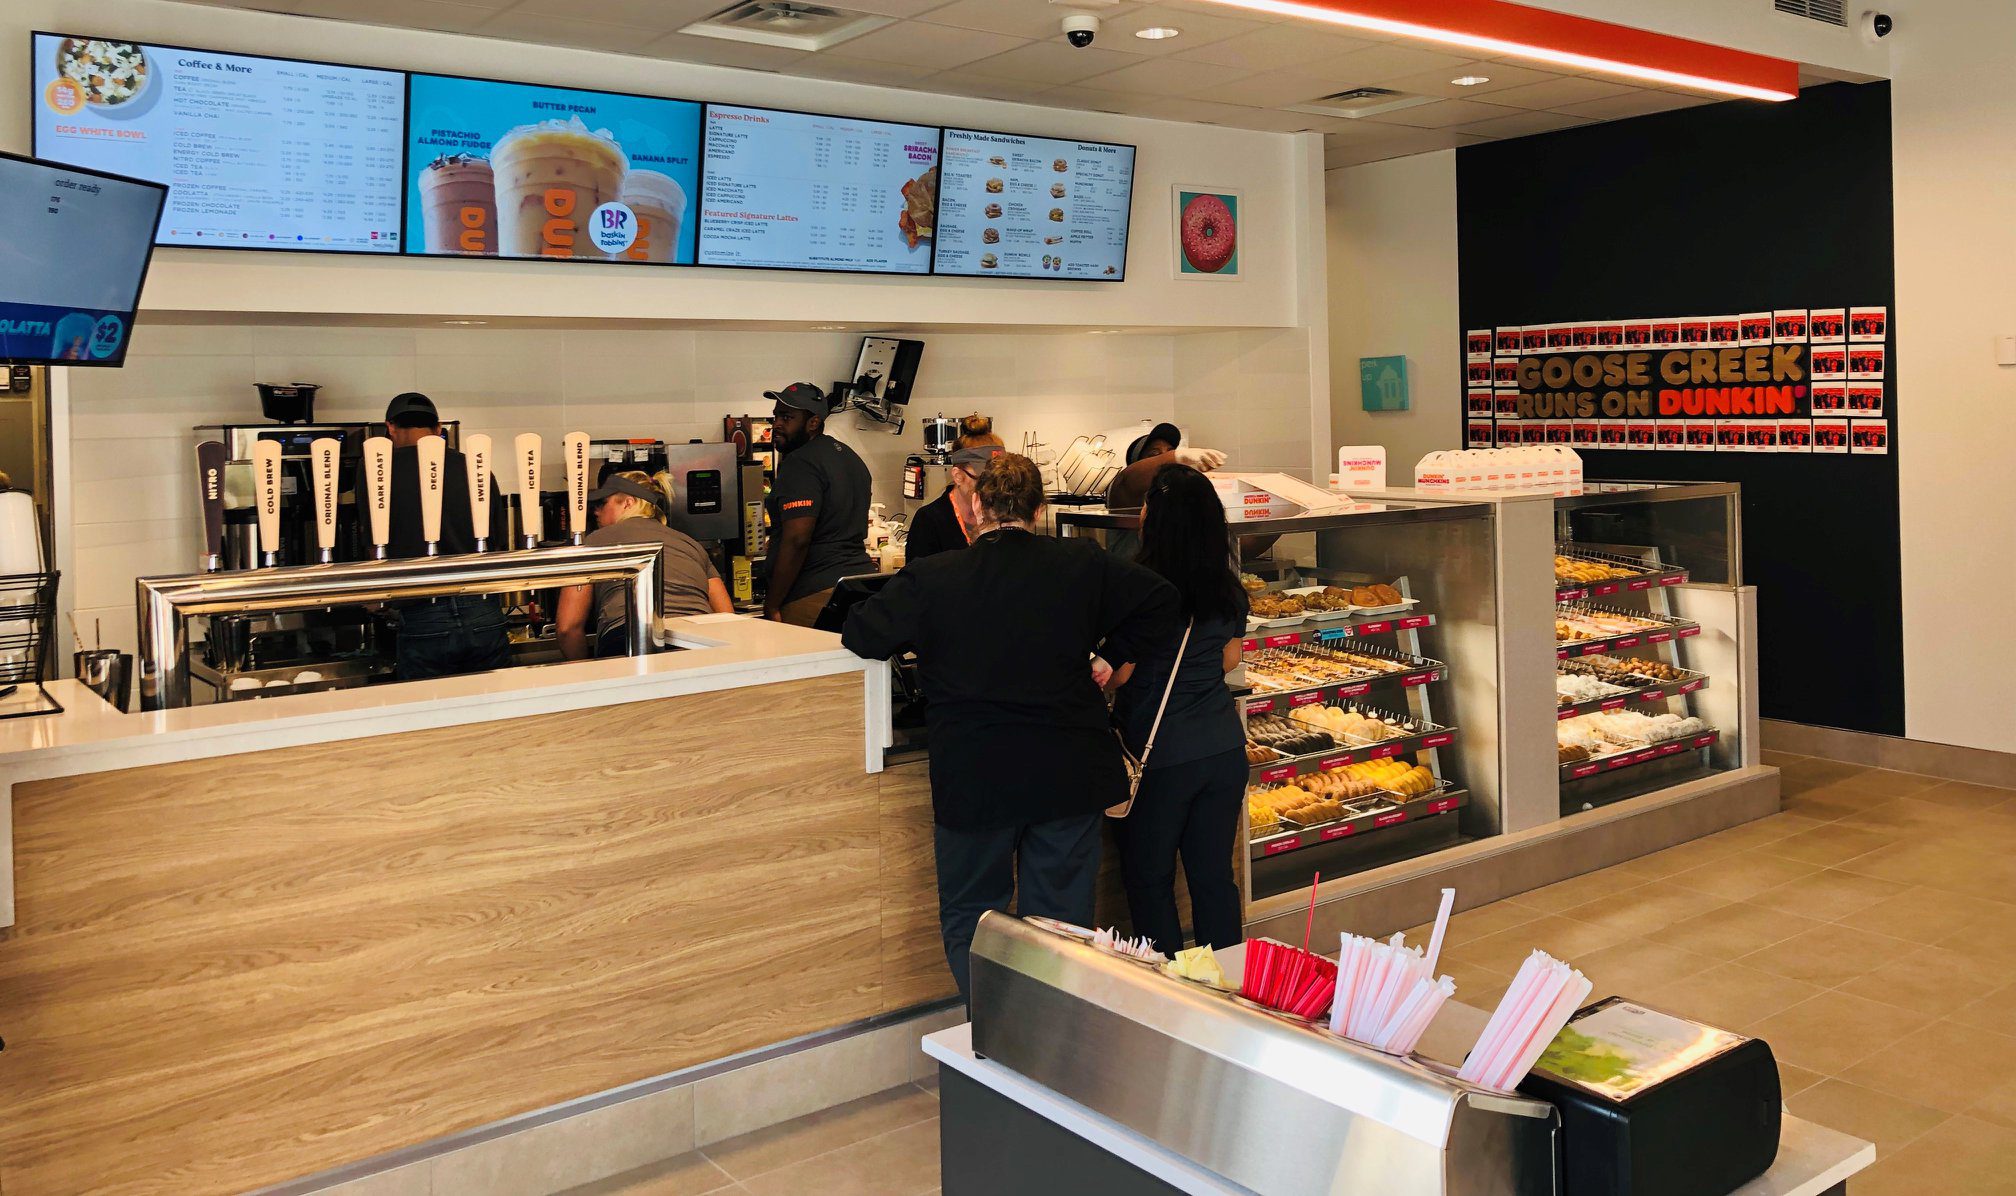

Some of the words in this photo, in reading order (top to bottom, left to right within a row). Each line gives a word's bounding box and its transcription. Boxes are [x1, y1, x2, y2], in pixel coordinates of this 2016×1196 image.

[178, 59, 213, 70] Coffee
[215, 63, 222, 71] &
[225, 64, 253, 74] More
[189, 99, 230, 107] CHOCOLATE
[532, 101, 566, 112] BUTTER
[567, 104, 596, 114] PECAN
[709, 111, 743, 120] Espresso
[743, 114, 770, 123] Drinks
[56, 125, 77, 134] EGG
[80, 127, 113, 137] WHITE
[117, 129, 147, 139] BOWL
[431, 129, 481, 140] PISTACHIO
[949, 131, 973, 141] Freshly
[973, 134, 989, 142] Made
[990, 136, 1026, 145] Sandwiches
[418, 137, 459, 148] ALMOND
[461, 140, 492, 150] FUDGE
[904, 145, 937, 154] SRIRACHA
[1077, 144, 1097, 152] Donuts
[632, 154, 666, 164] BANANA
[666, 156, 689, 165] SPLIT
[908, 153, 932, 161] BACON
[55, 179, 77, 190] order
[79, 184, 101, 196] ready
[601, 209, 628, 230] BR
[704, 210, 738, 218] Featured
[739, 212, 776, 220] Signature
[776, 214, 799, 222] Lattes
[601, 231, 626, 240] baskin
[0, 319, 51, 336] OLATTA
[96, 321, 119, 343] $2
[1517, 353, 1652, 390] GOOSE
[1660, 345, 1804, 385] CREEK
[1517, 391, 1595, 418] RUNS
[1601, 390, 1649, 417] ON
[1659, 385, 1806, 415] DUNKIN'
[266, 458, 274, 485] BREW
[377, 452, 385, 482] ROAST
[208, 468, 218, 500] NITRO
[783, 499, 814, 511] DUNKIN'
[1244, 496, 1271, 504] DUNKIN'
